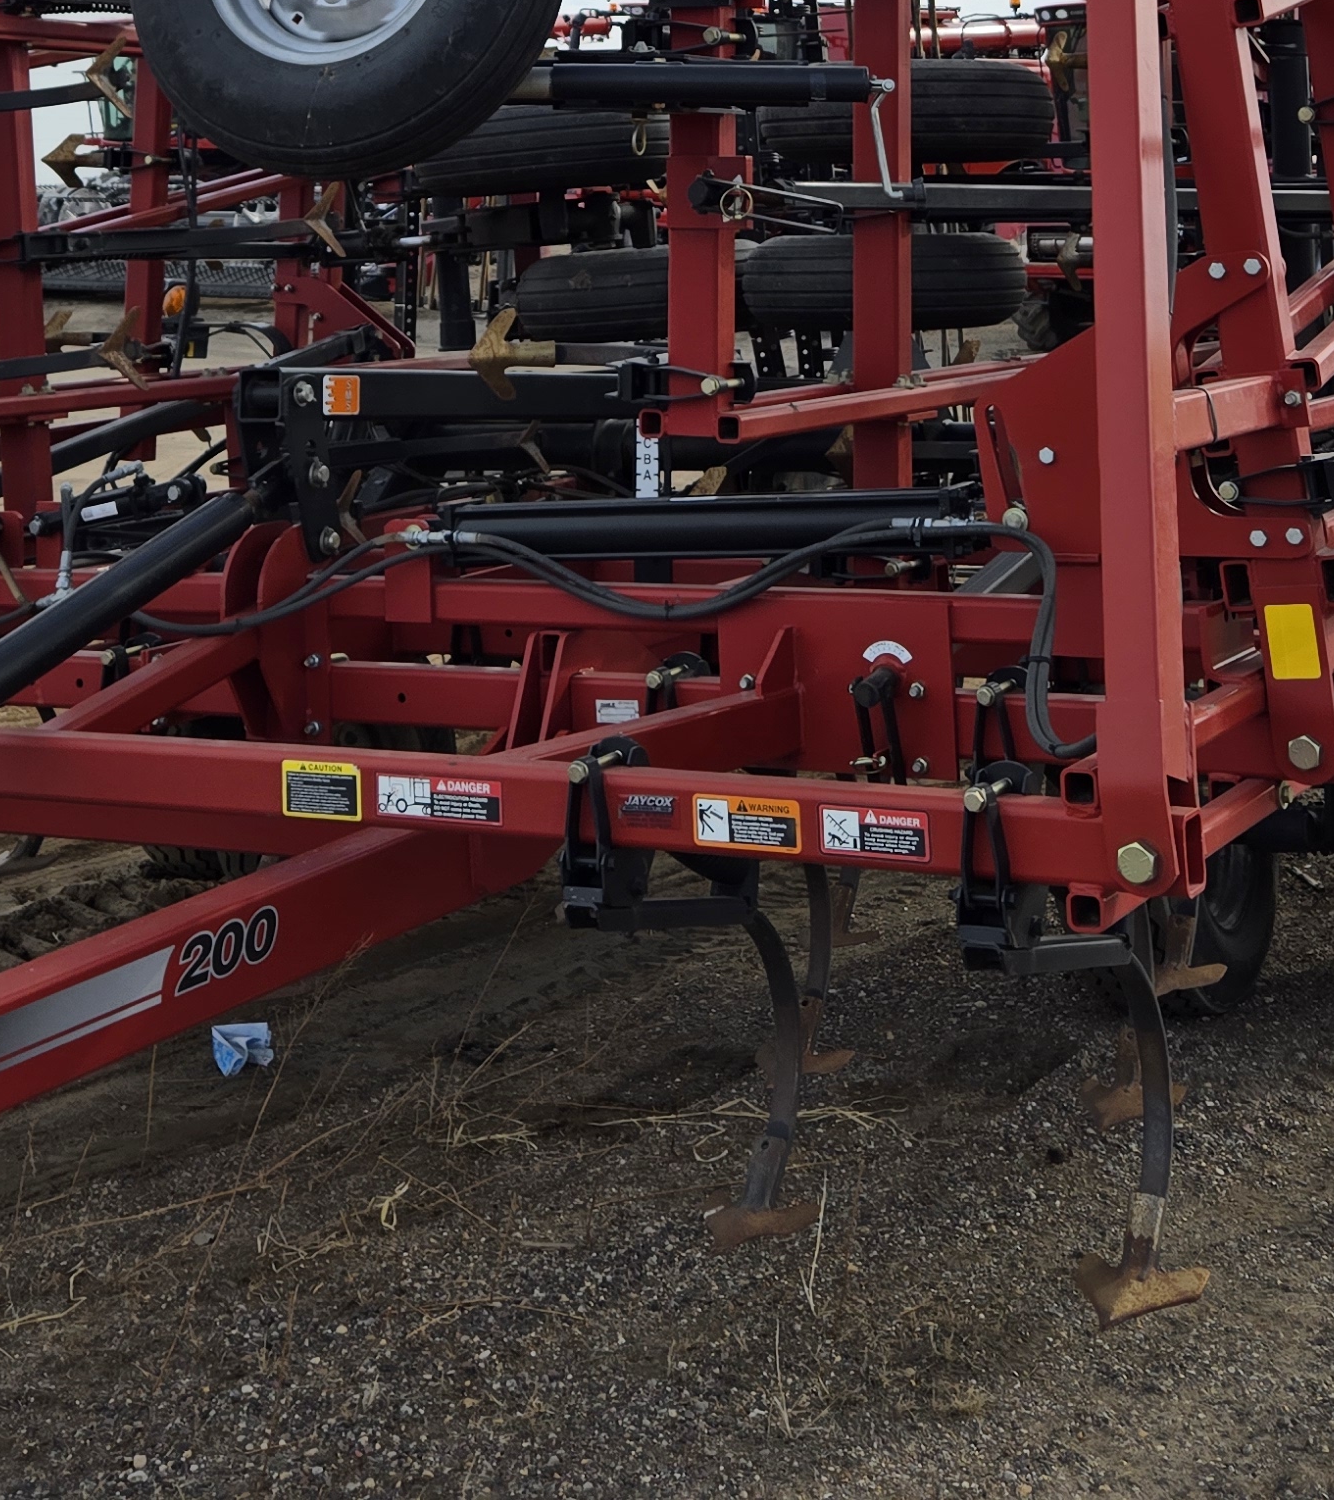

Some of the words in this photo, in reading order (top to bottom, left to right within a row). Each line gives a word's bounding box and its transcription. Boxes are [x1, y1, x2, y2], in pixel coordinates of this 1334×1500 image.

[643, 438, 651, 449] C
[643, 454, 651, 465] B
[643, 469, 652, 481] A
[308, 763, 343, 772] CAUTION
[447, 781, 490, 794] DANGER
[624, 795, 674, 807] JAYCOX
[748, 803, 790, 814] WARNING
[879, 815, 920, 828] DANGER
[174, 905, 279, 997] 200
